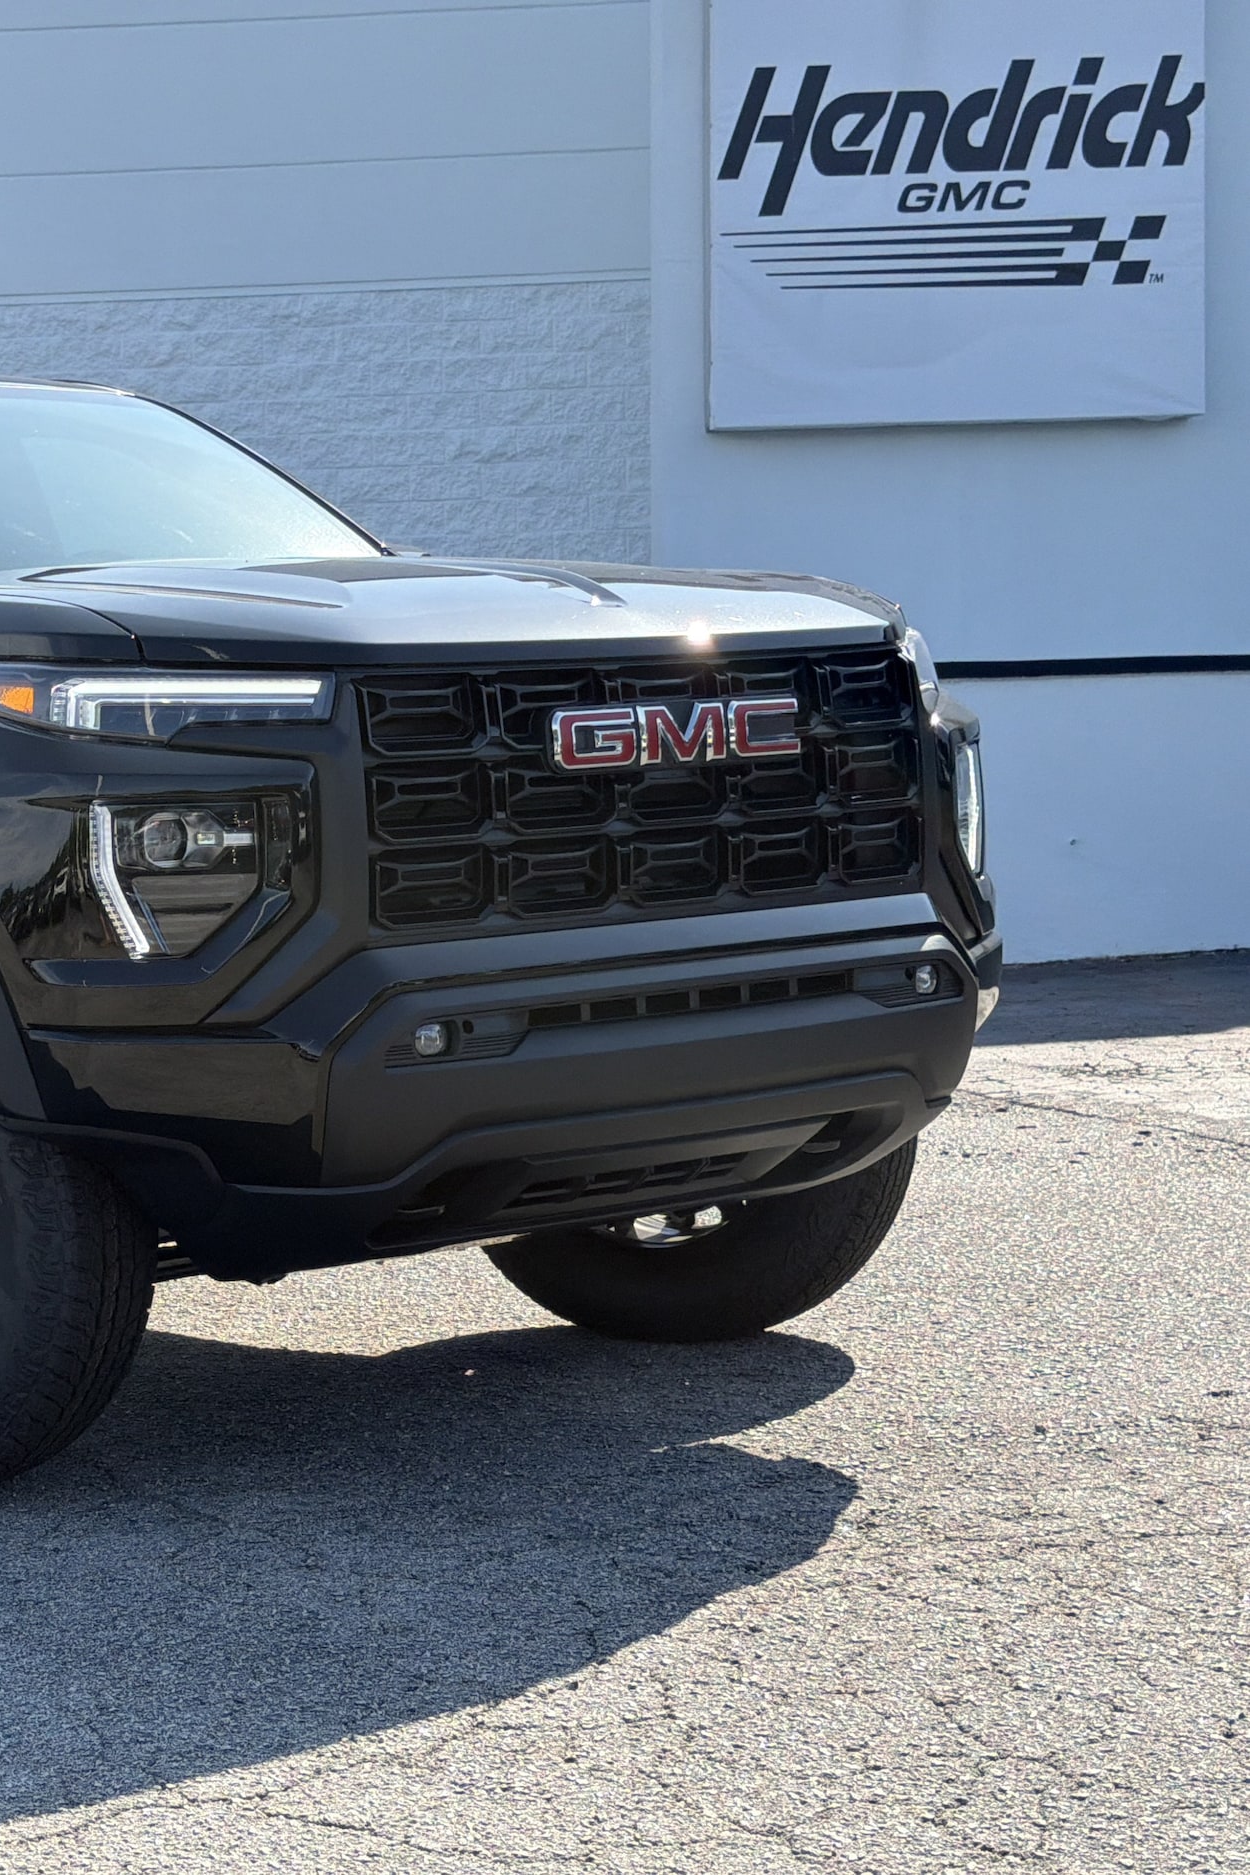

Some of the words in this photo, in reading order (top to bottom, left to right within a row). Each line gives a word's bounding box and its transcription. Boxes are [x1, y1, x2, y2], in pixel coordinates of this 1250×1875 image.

[717, 55, 1205, 217] Hendrick
[897, 180, 1030, 213] GMC
[551, 698, 801, 770] GMC
